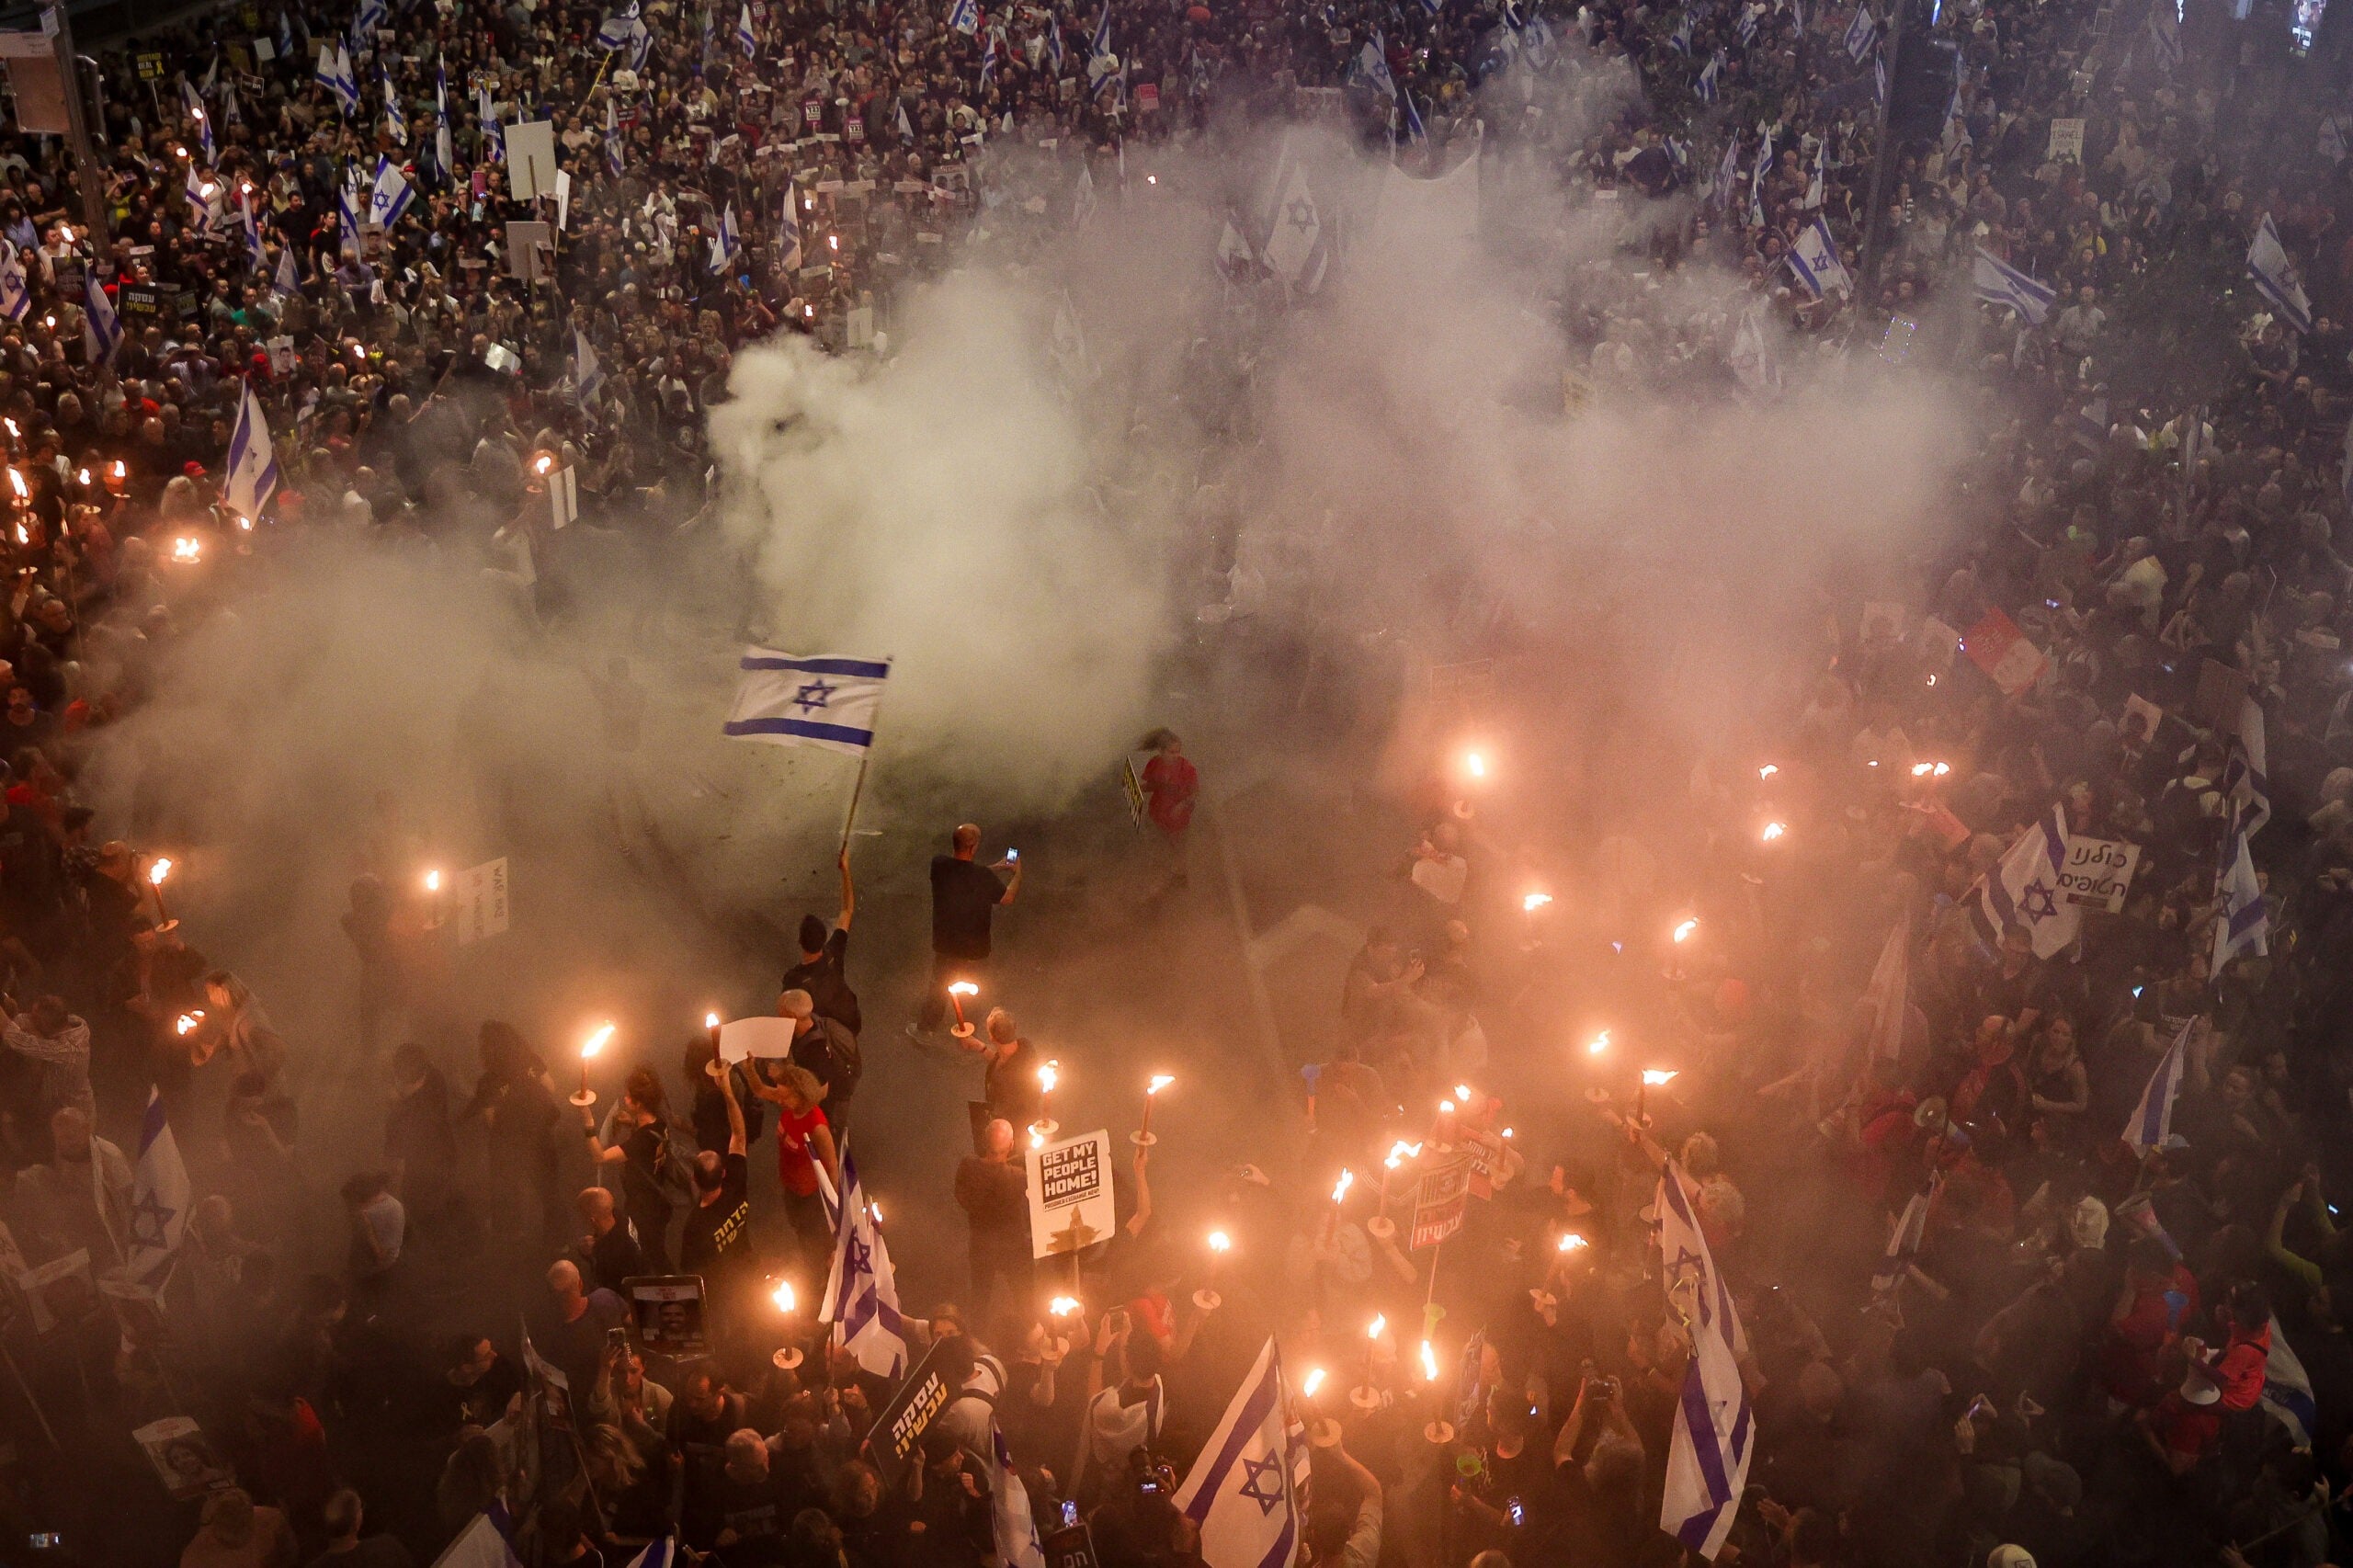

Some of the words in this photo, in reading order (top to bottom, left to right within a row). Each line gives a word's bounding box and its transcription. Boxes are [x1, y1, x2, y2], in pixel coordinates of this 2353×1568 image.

[2070, 844, 2127, 868] כולנו
[1042, 1148, 1071, 1167] GET
[1073, 1142, 1095, 1159] MY
[1043, 1156, 1097, 1181] PEOPLE
[1044, 1170, 1097, 1198] HOME!
[892, 1370, 938, 1441] עסקה
